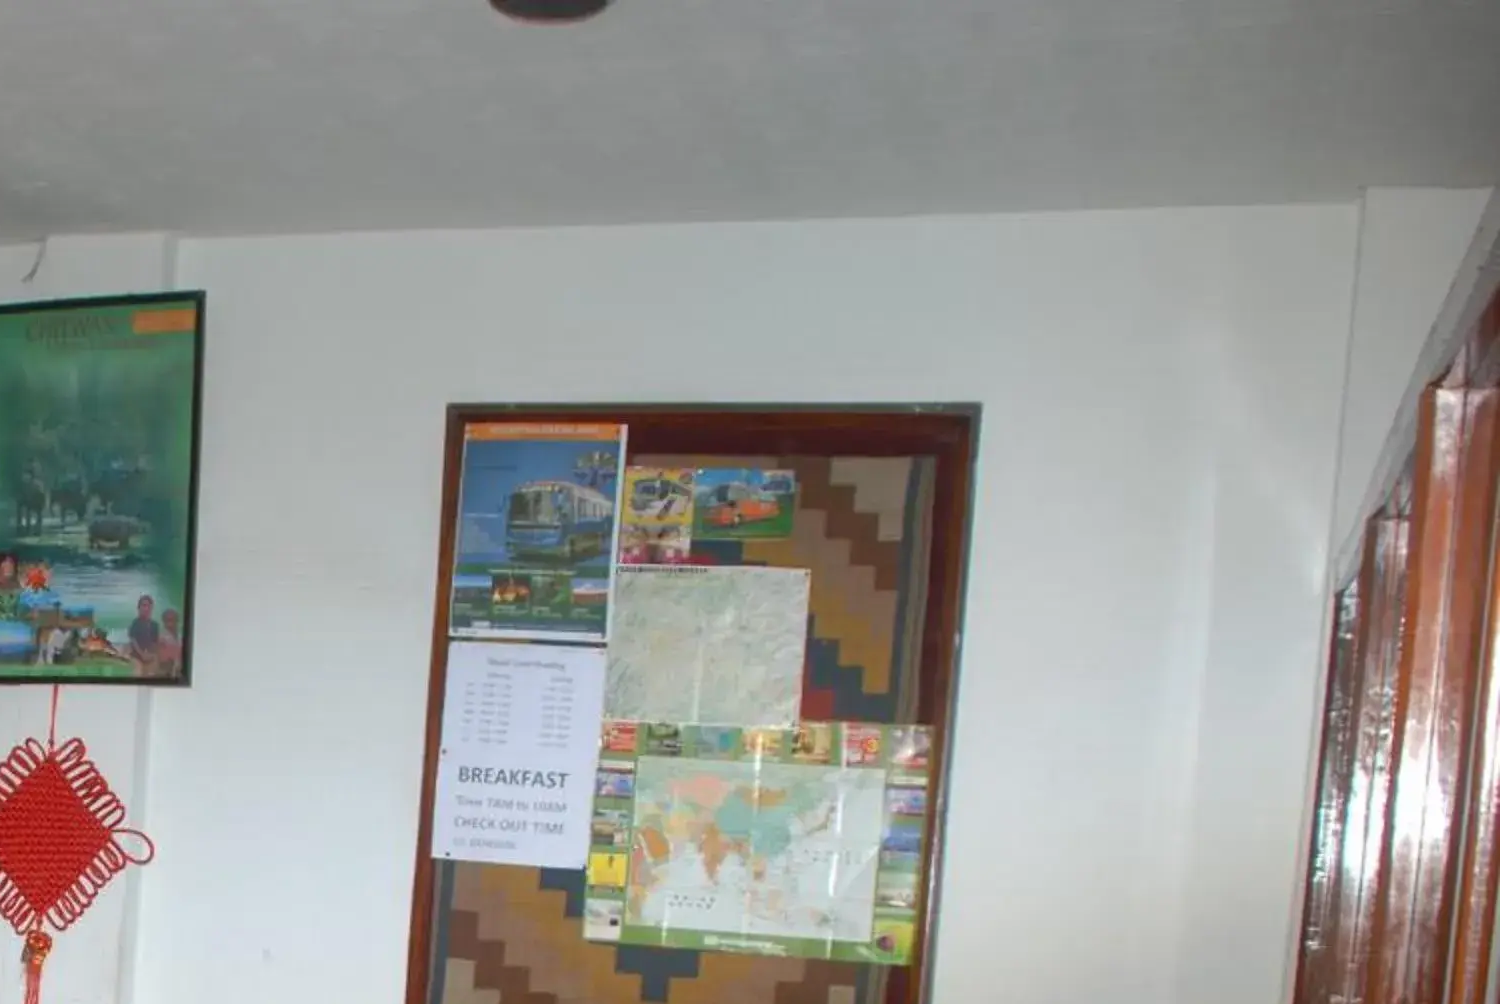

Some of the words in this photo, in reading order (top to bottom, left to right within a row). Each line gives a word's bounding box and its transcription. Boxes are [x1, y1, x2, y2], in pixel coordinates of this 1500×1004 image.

[458, 765, 571, 789] BREAKFAST
[453, 816, 496, 831] CHECK
[499, 819, 528, 833] OUT
[532, 821, 565, 835] TIME
